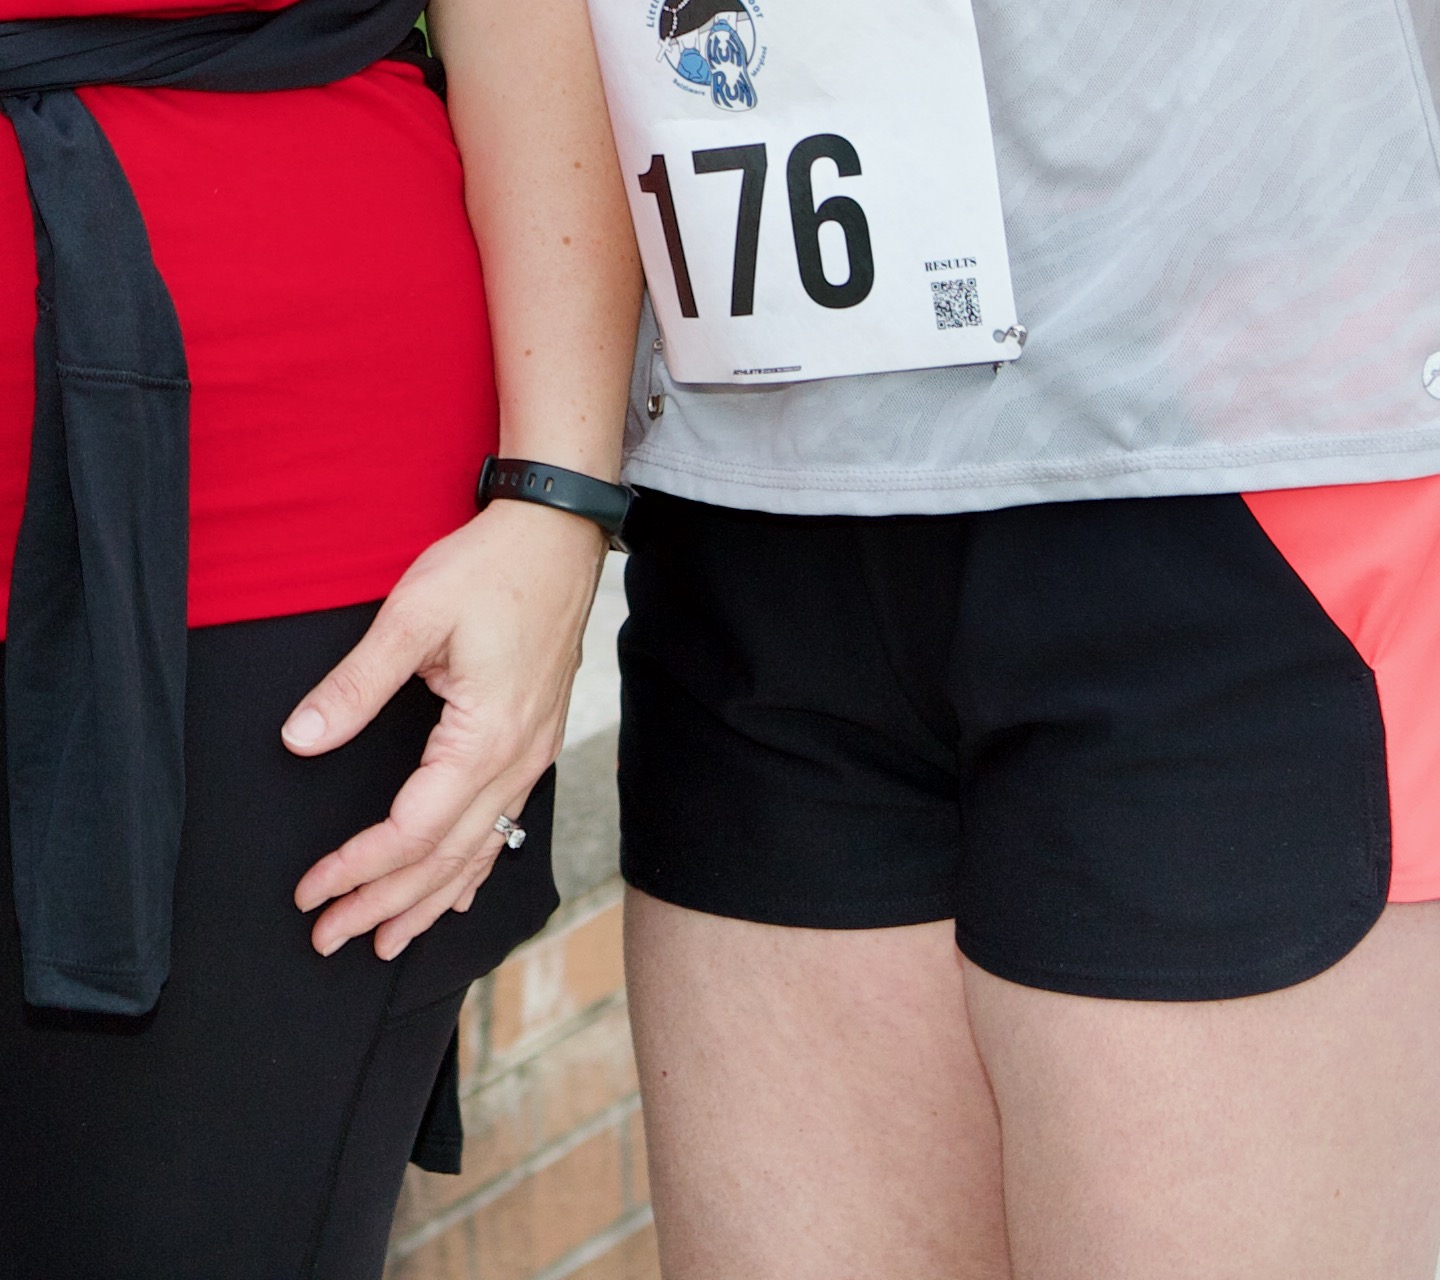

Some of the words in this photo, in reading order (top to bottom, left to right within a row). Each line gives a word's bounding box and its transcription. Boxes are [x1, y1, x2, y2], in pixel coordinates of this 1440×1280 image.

[712, 70, 753, 109] RUN
[637, 132, 875, 319] 176
[925, 256, 977, 272] RESULTS
